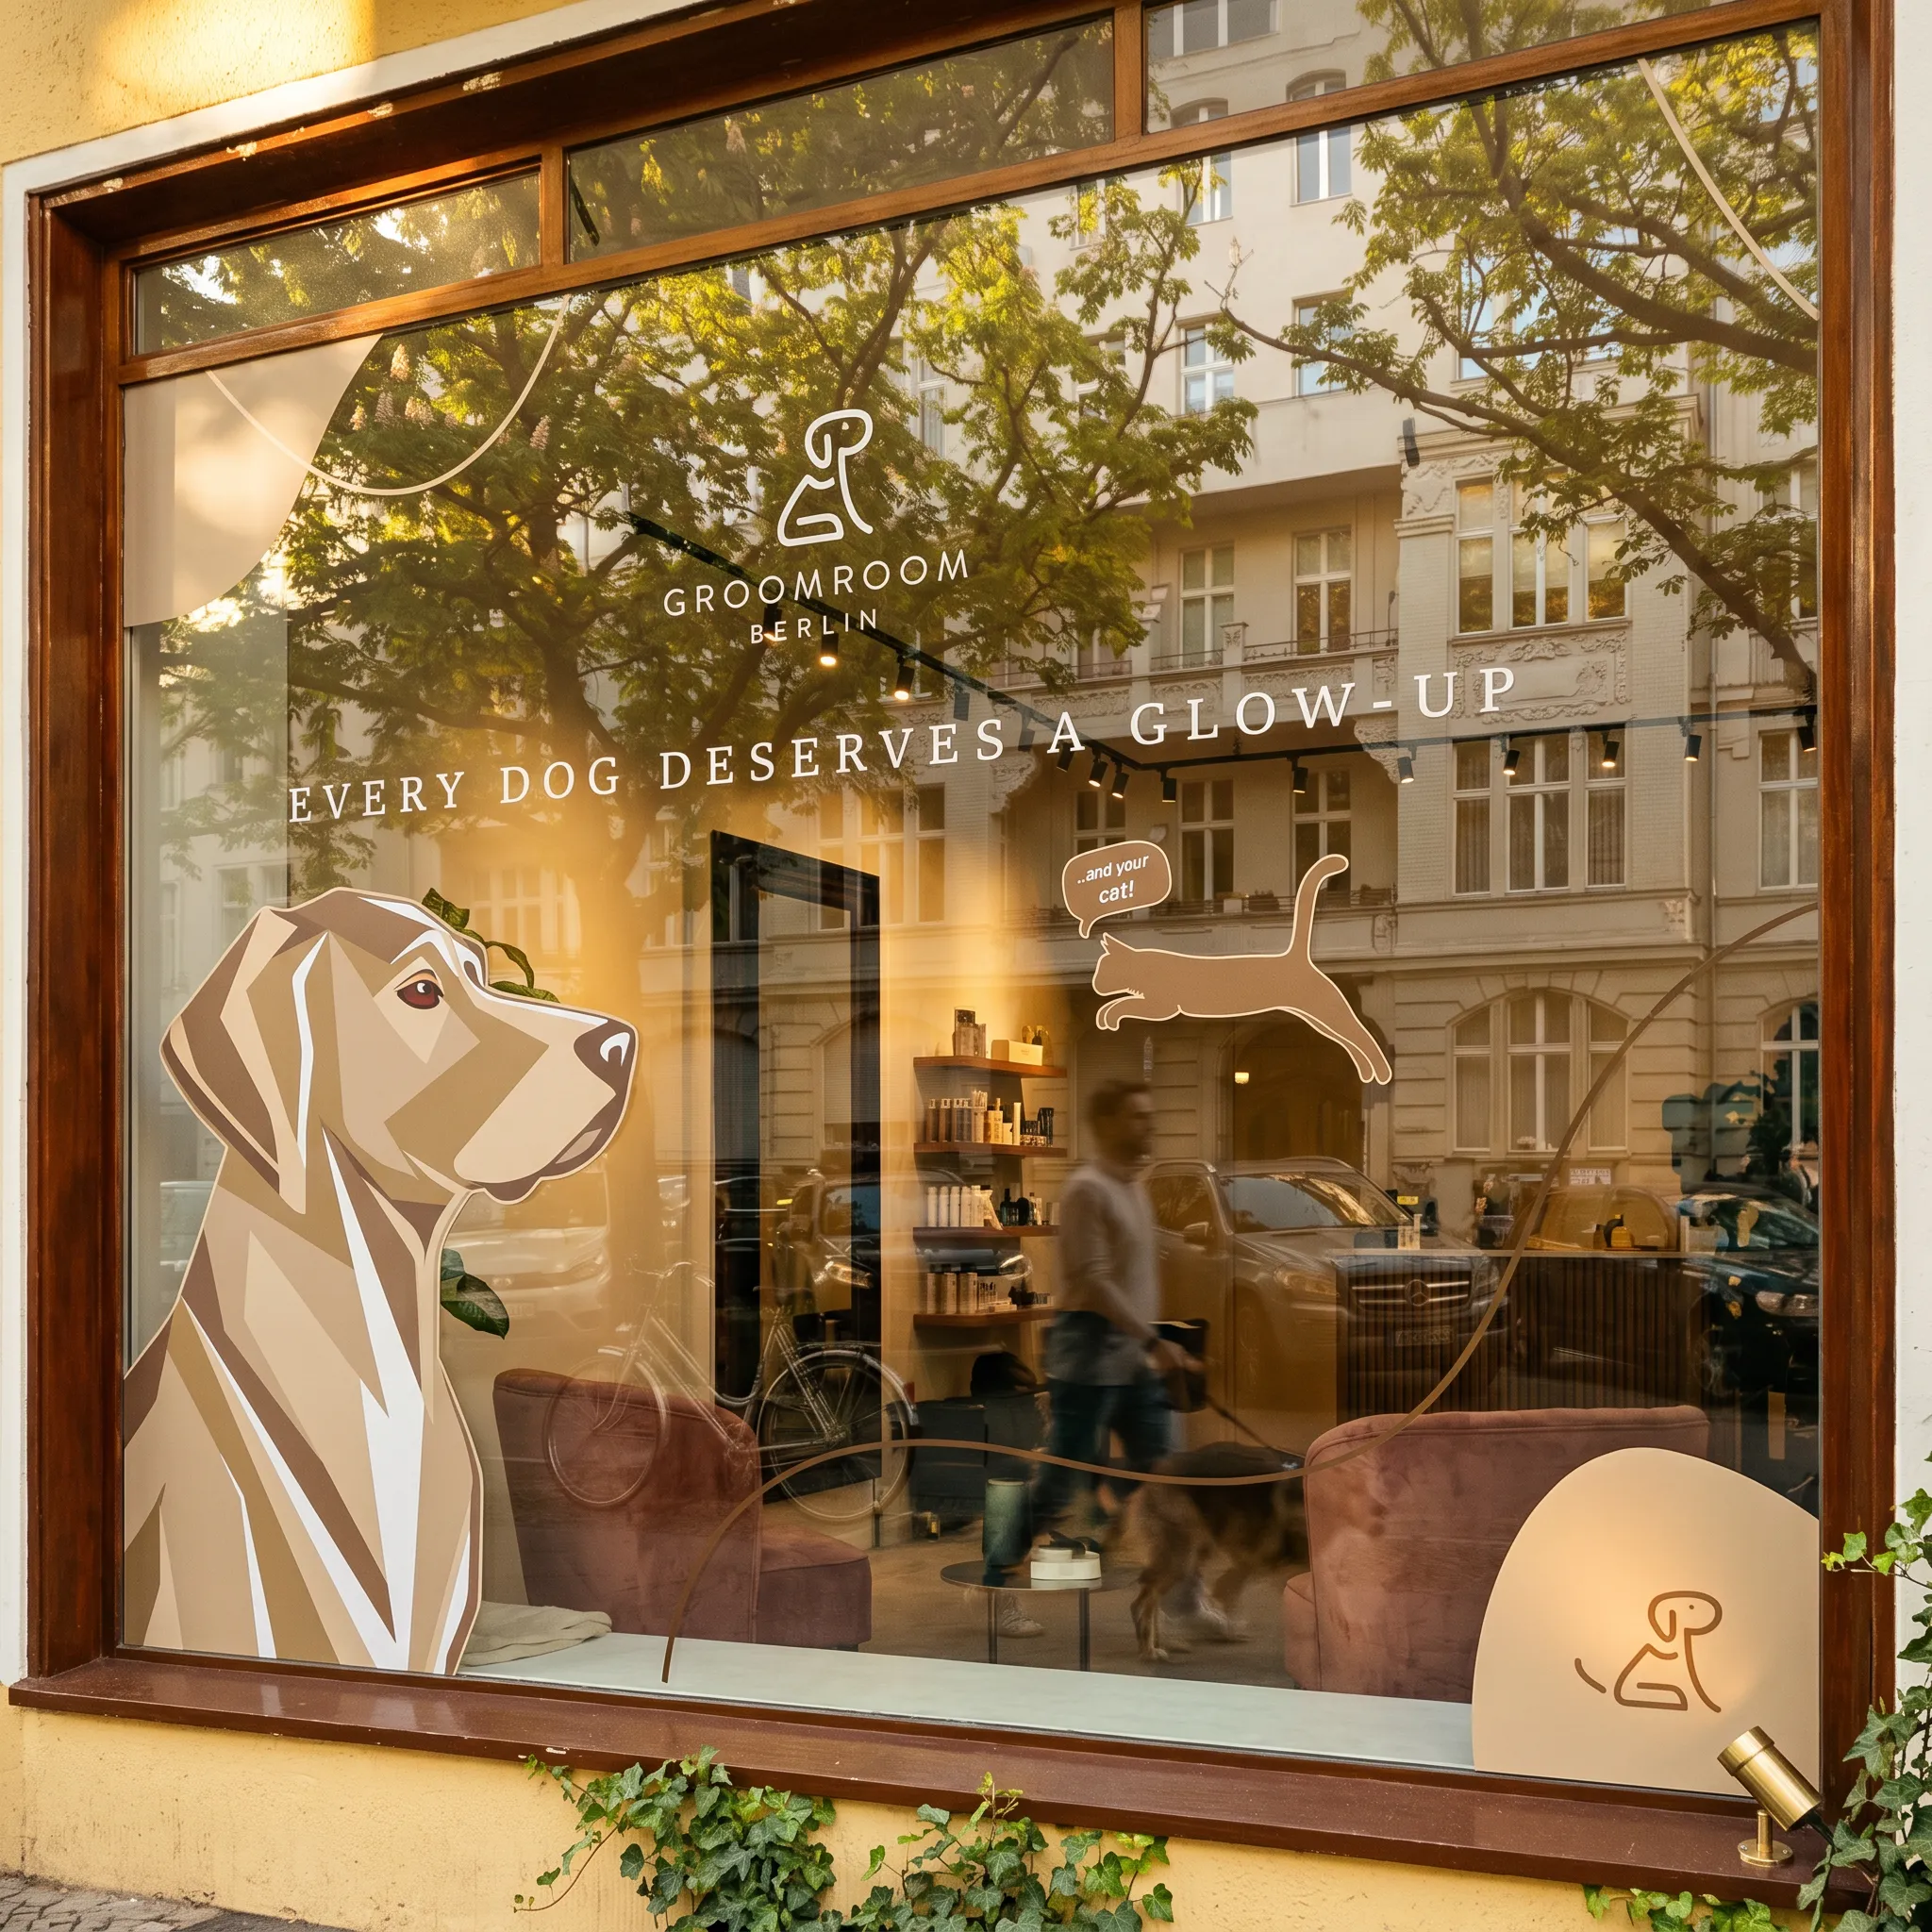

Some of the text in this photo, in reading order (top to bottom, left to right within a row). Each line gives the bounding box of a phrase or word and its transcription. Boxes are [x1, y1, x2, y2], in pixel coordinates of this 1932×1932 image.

[663, 549, 968, 617] GROOMROOM
[750, 608, 876, 644] BERLIN
[288, 666, 1515, 823] EVERY DOG DESERVES A GLOW-UP
[1116, 855, 1150, 877] your
[1098, 879, 1134, 904] cat!
